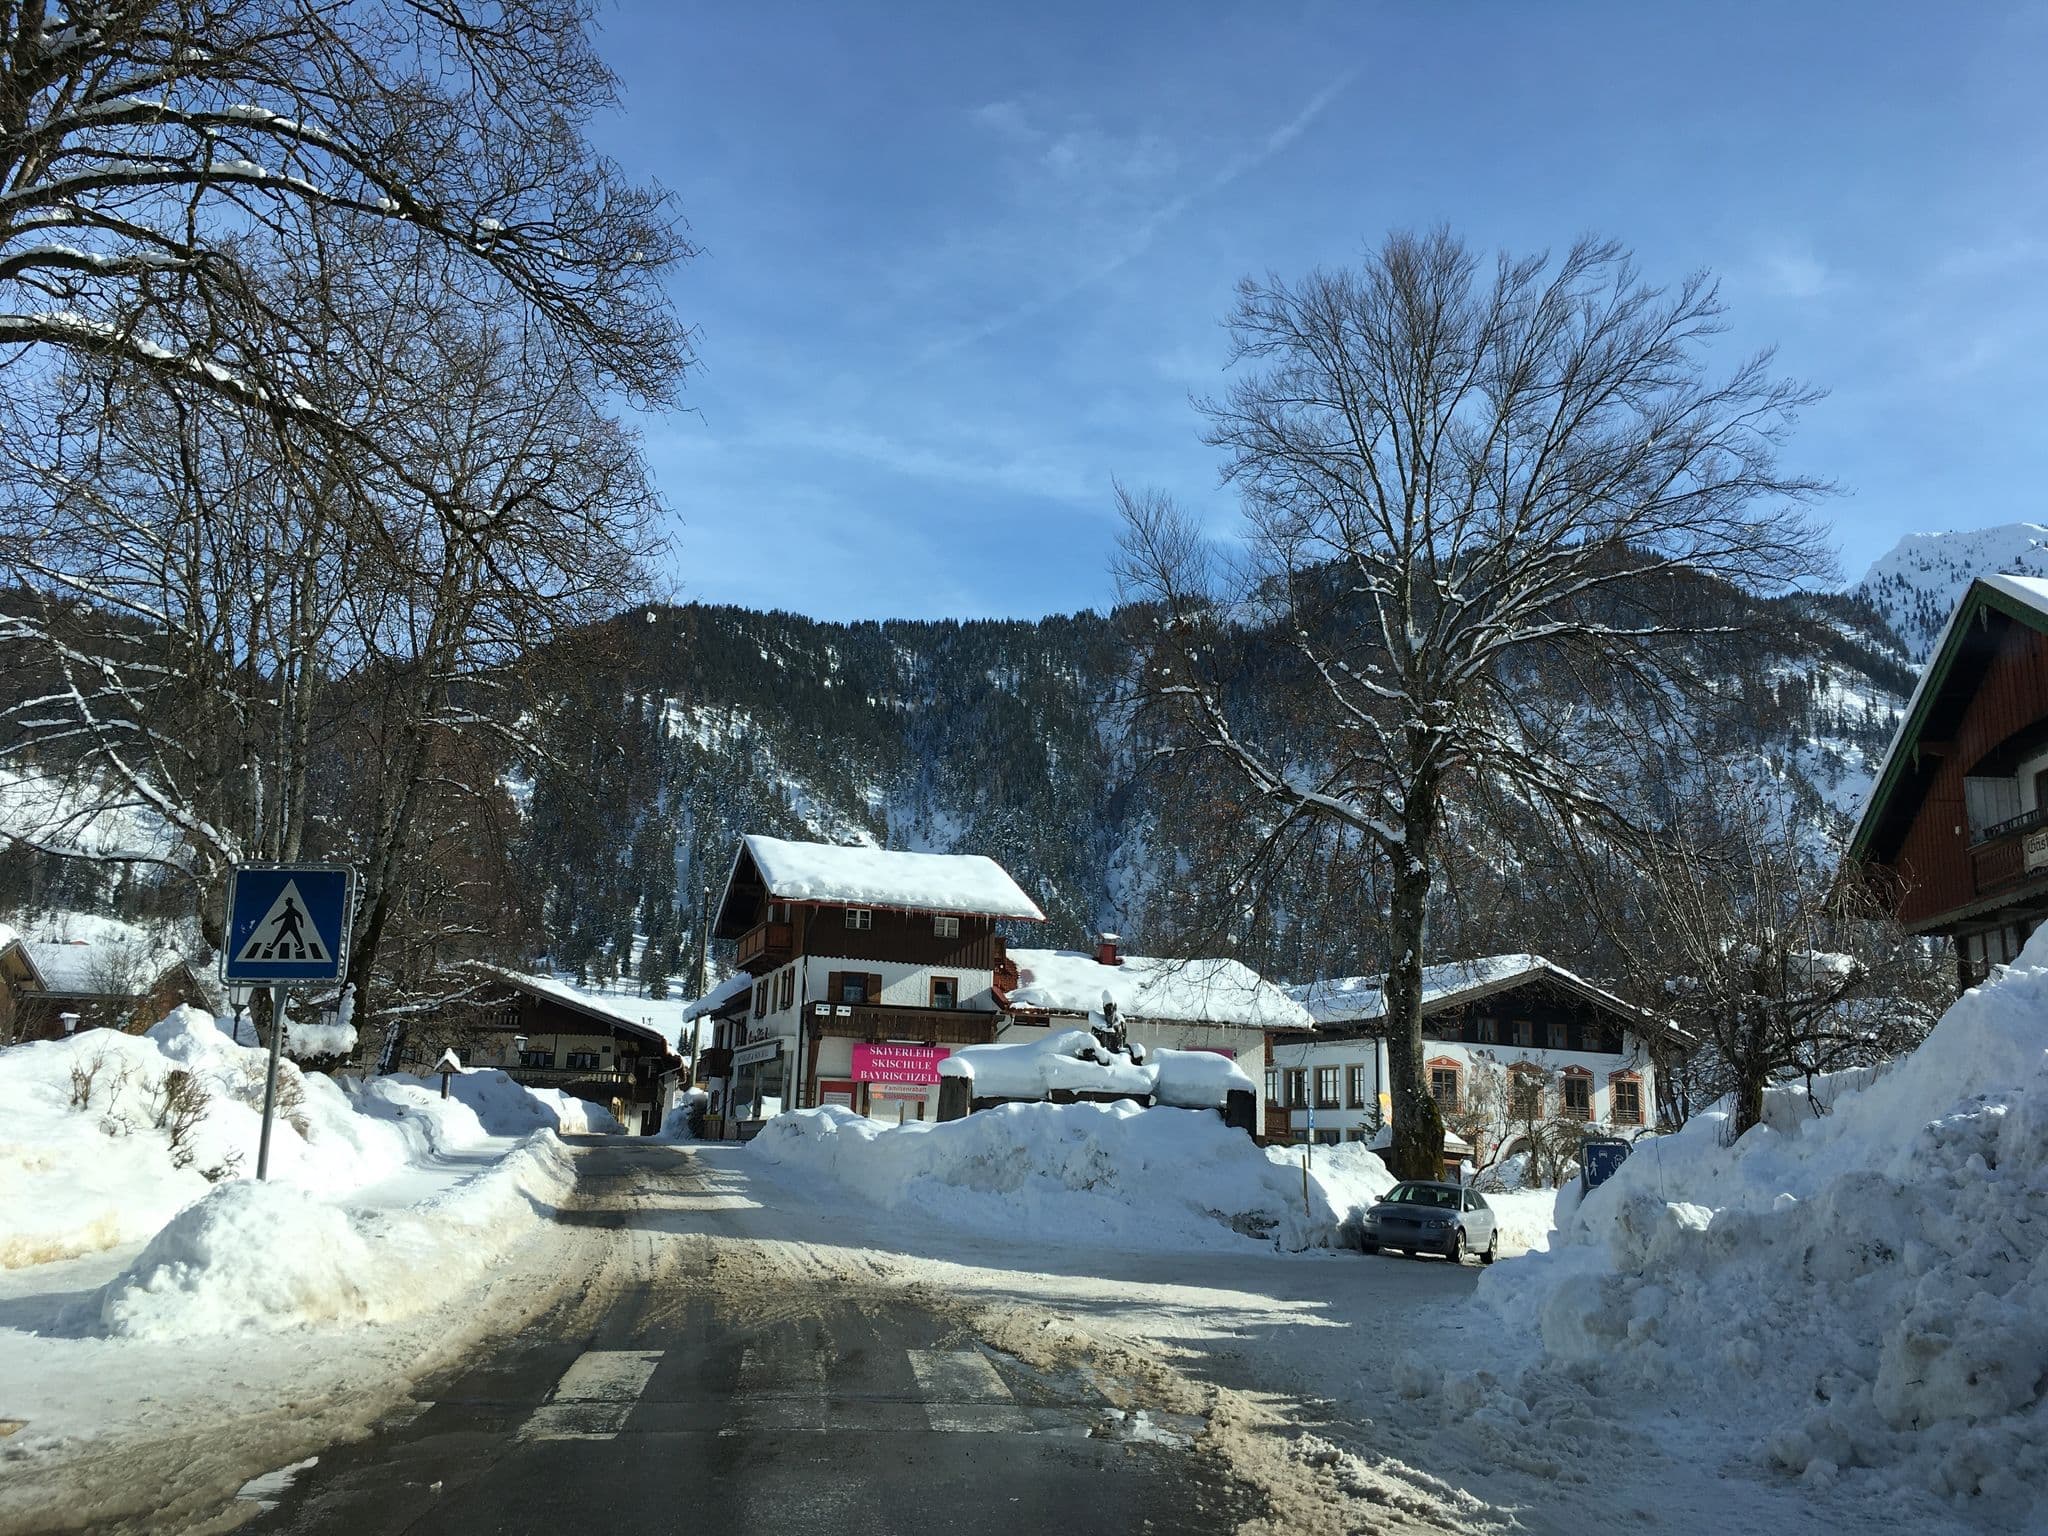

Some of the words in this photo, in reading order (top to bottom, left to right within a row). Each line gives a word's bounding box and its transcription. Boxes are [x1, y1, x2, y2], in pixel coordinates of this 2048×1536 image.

[869, 1046, 934, 1058] SKIVERLEIH
[871, 1058, 932, 1070] SKISCHULE
[860, 1070, 941, 1083] BAYRISCHZELL
